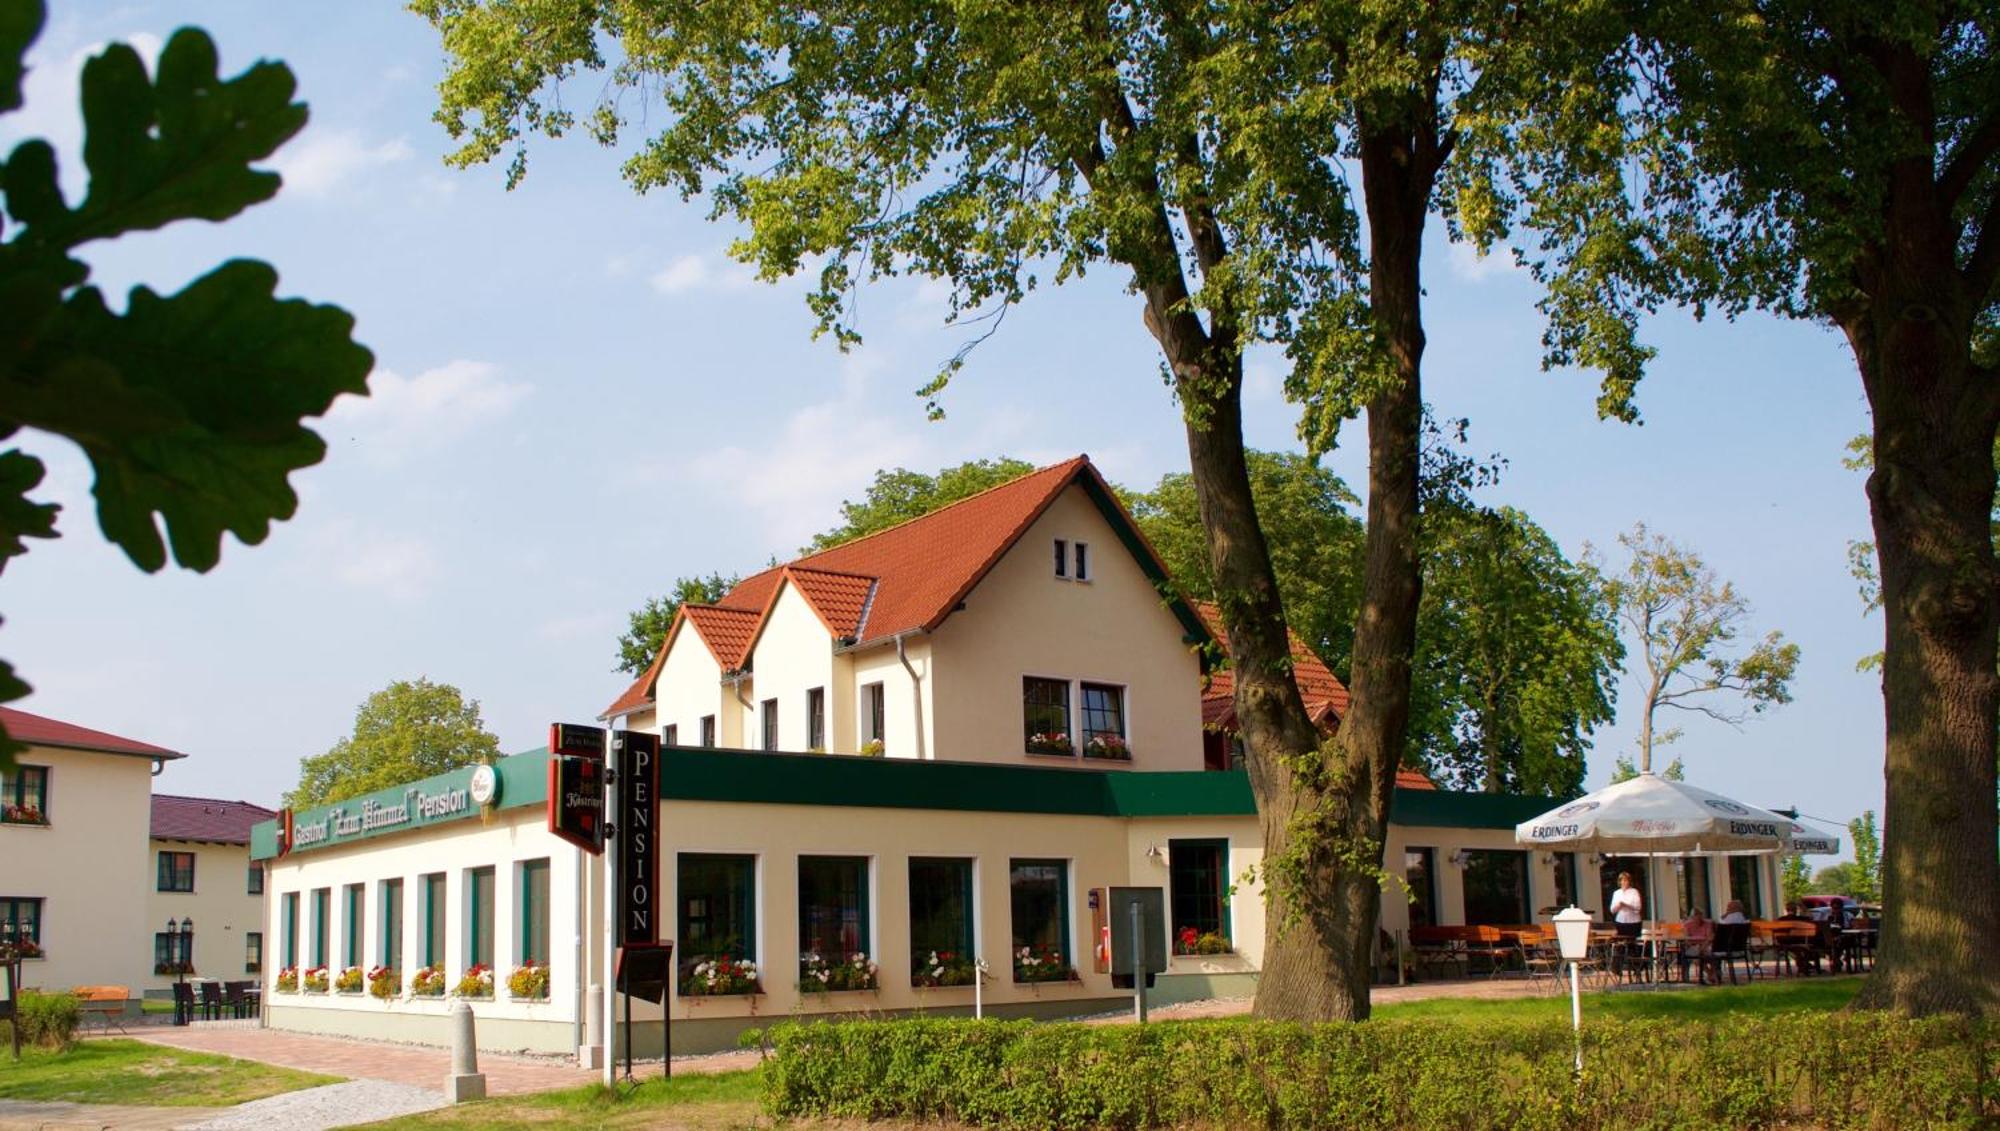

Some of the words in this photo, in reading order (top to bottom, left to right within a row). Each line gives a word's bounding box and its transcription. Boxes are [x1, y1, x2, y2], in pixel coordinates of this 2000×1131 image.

[295, 817, 328, 845] Gasthof
[418, 787, 467, 819] Pension
[1532, 824, 1579, 838] ERDINGER
[1731, 821, 1778, 837] ERDINGER
[633, 751, 649, 929] PENSION
[1793, 839, 1828, 850] ERDINGER
